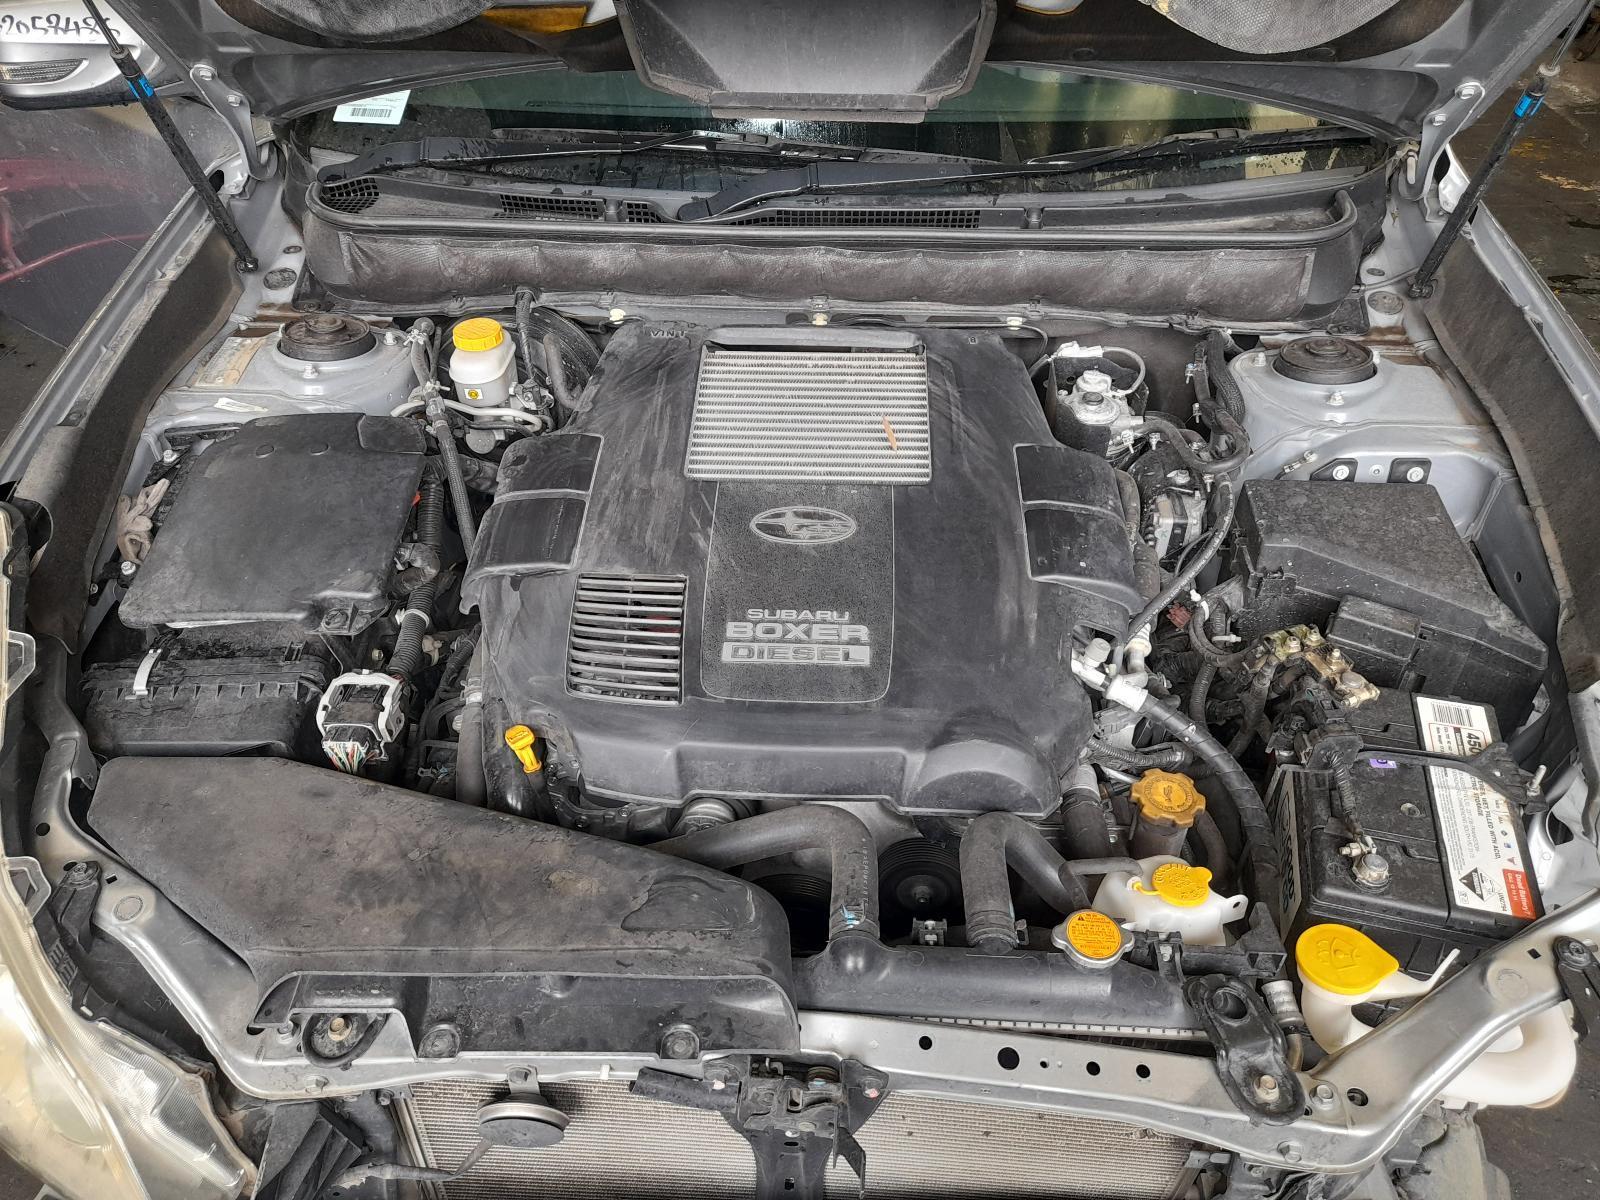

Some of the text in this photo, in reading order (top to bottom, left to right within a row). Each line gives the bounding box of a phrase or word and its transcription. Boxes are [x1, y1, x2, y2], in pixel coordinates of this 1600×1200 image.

[747, 608, 850, 621] SUBARU
[726, 621, 870, 642] BOXER
[730, 644, 866, 663] DIESEL
